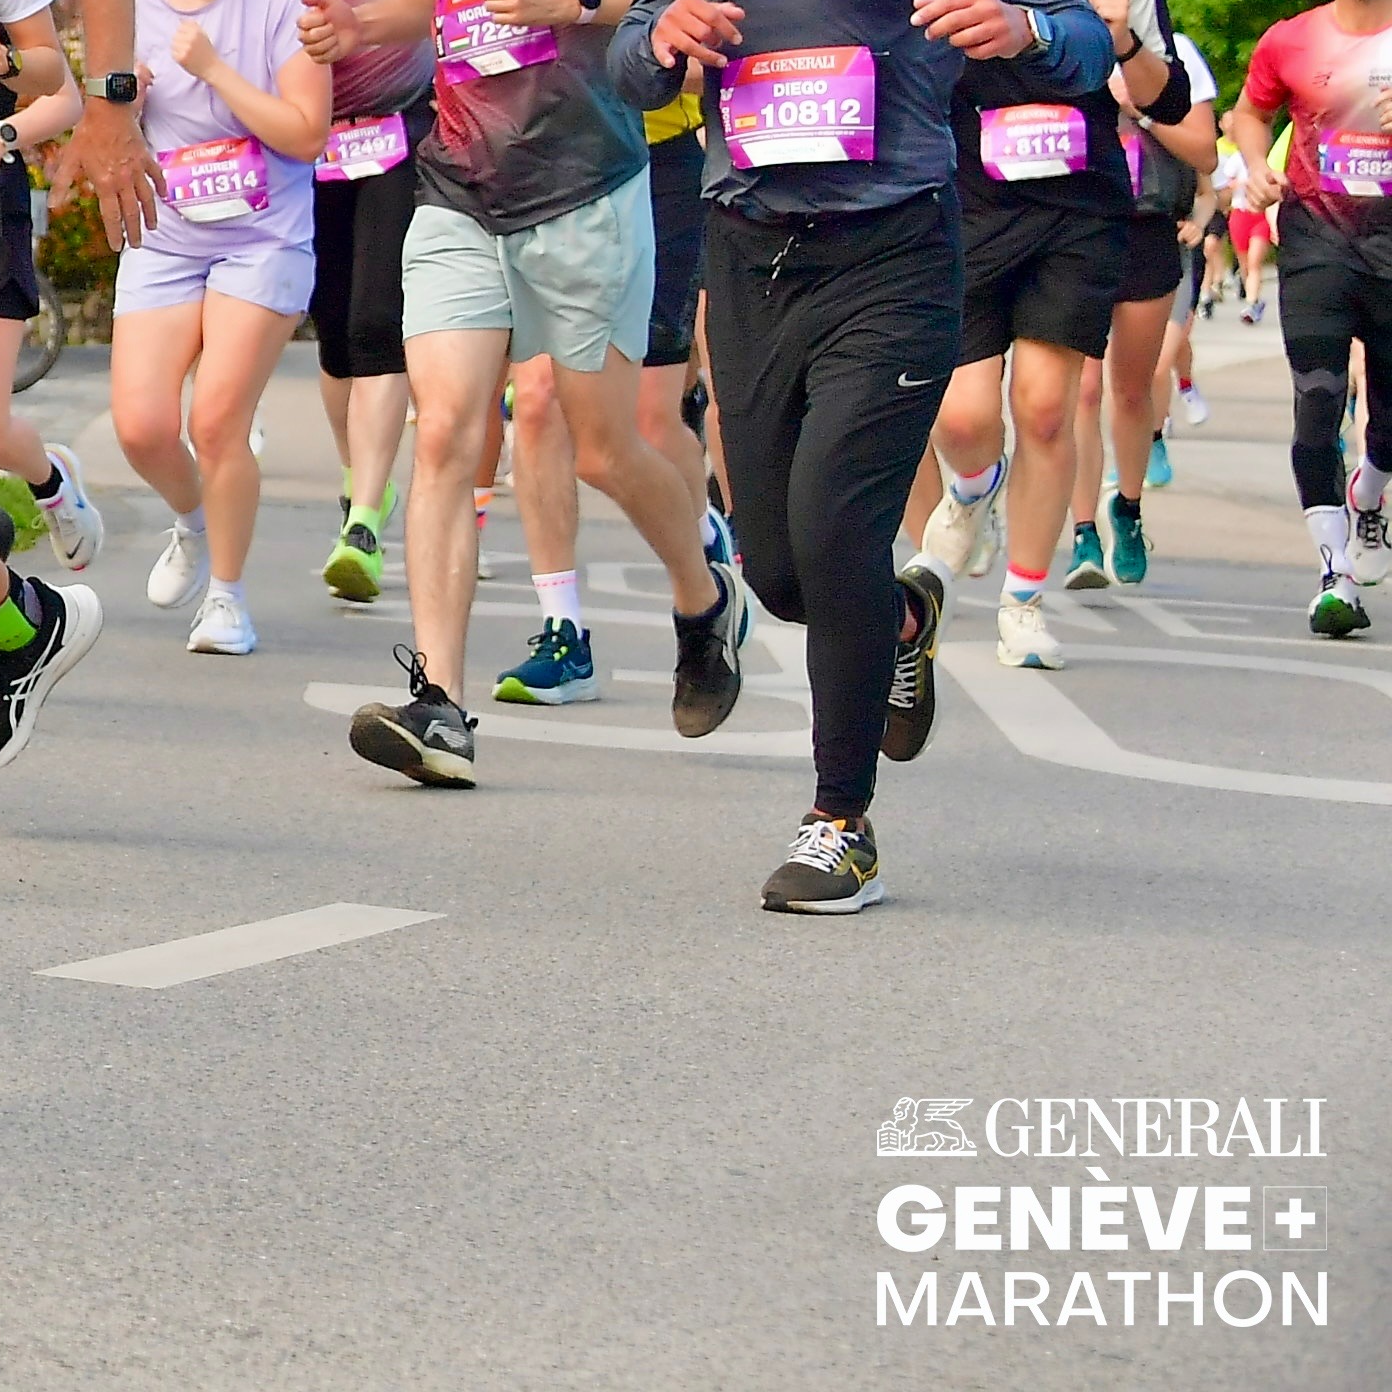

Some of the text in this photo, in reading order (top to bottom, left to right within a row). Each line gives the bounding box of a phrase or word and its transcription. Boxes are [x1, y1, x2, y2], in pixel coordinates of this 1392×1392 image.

[770, 55, 836, 73] GENERALI
[773, 80, 828, 98] DIEGO
[760, 98, 861, 129] 10812
[189, 170, 258, 197] 11314
